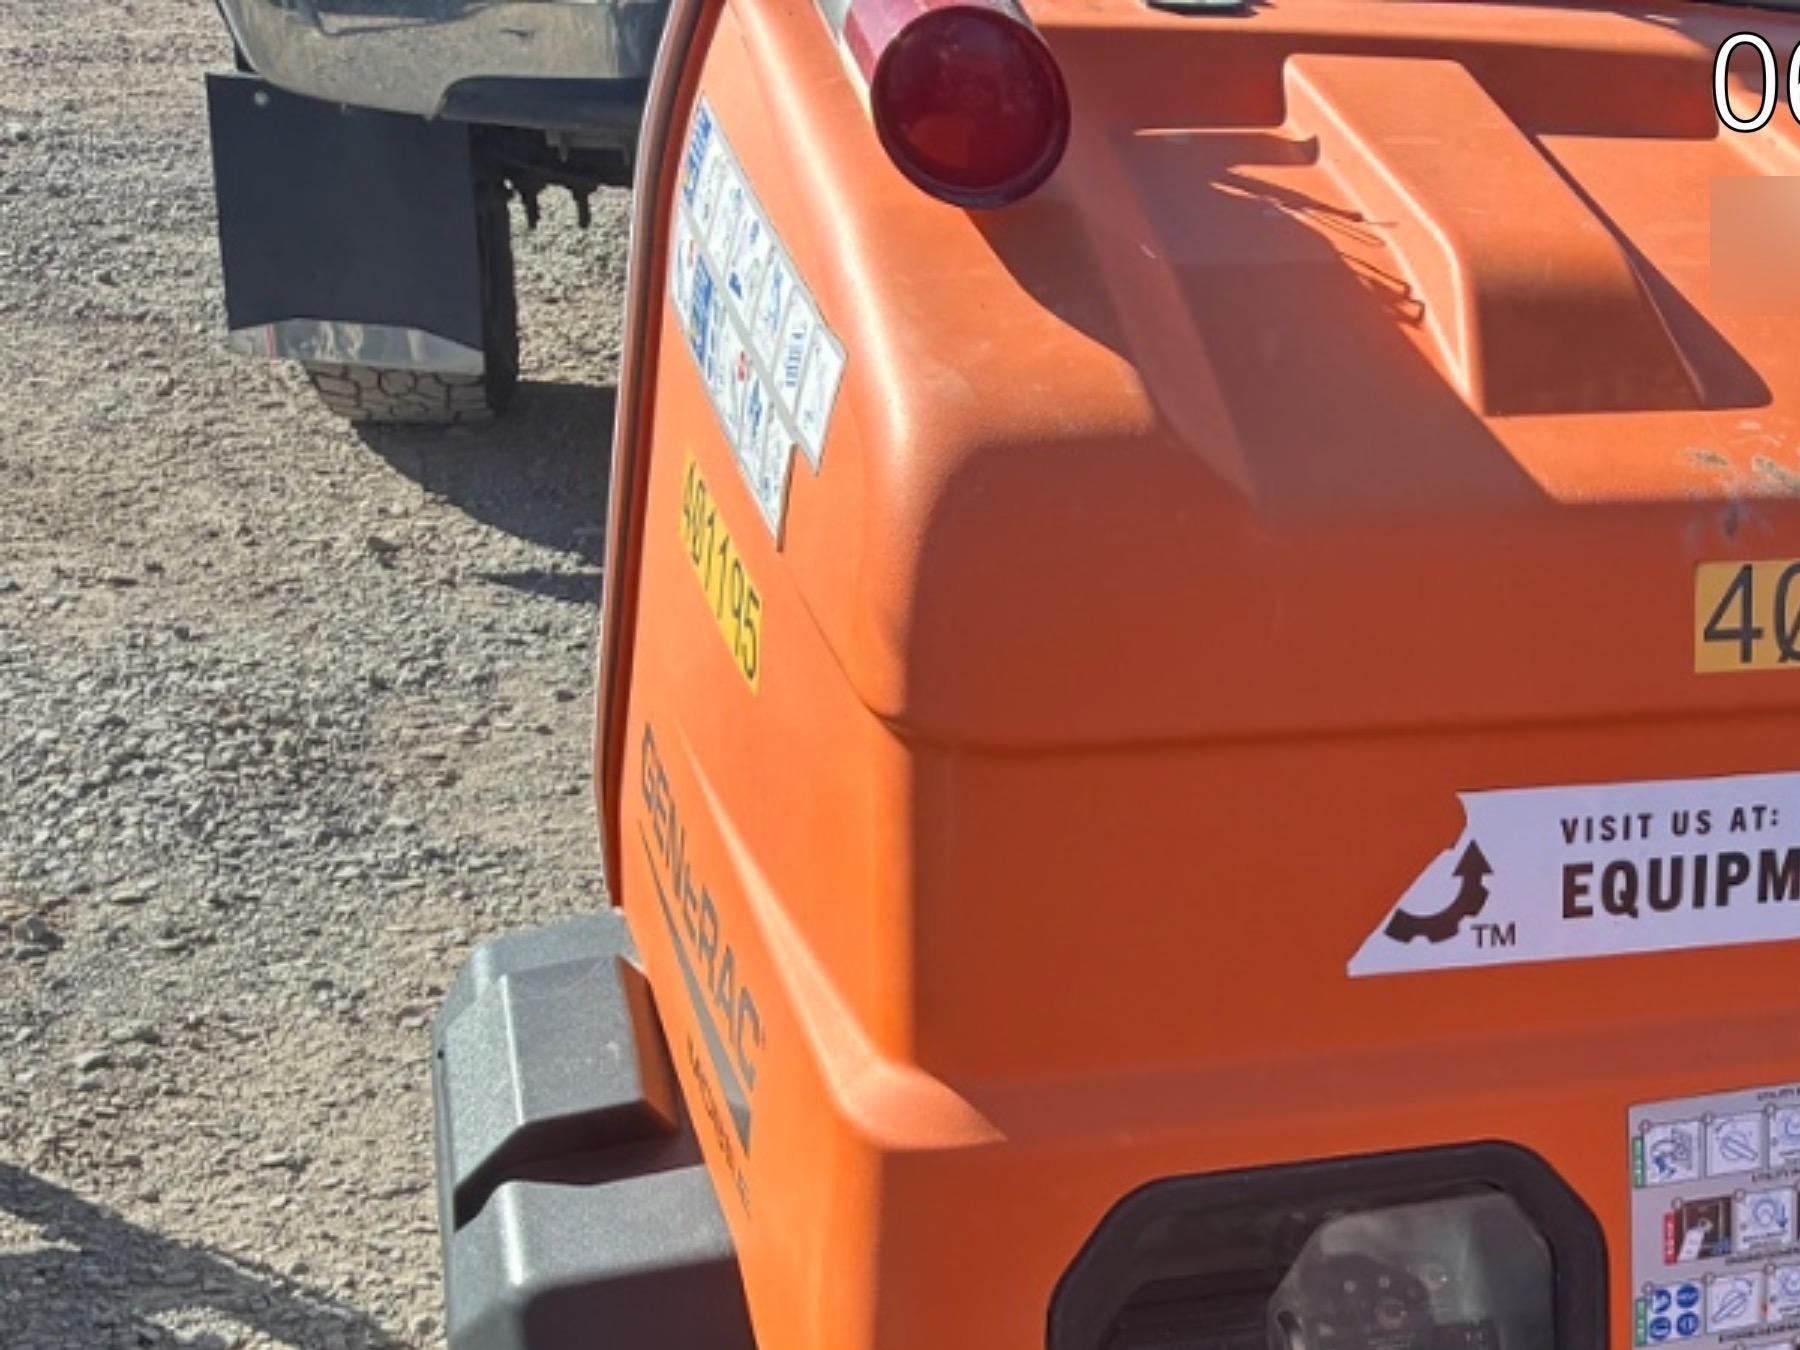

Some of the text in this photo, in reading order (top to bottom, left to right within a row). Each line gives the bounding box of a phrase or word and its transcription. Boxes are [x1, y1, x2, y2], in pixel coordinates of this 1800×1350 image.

[1560, 804, 1780, 844] VISIT US AT:
[640, 721, 764, 1091] GENERAC
[1471, 922, 1517, 947] TM
